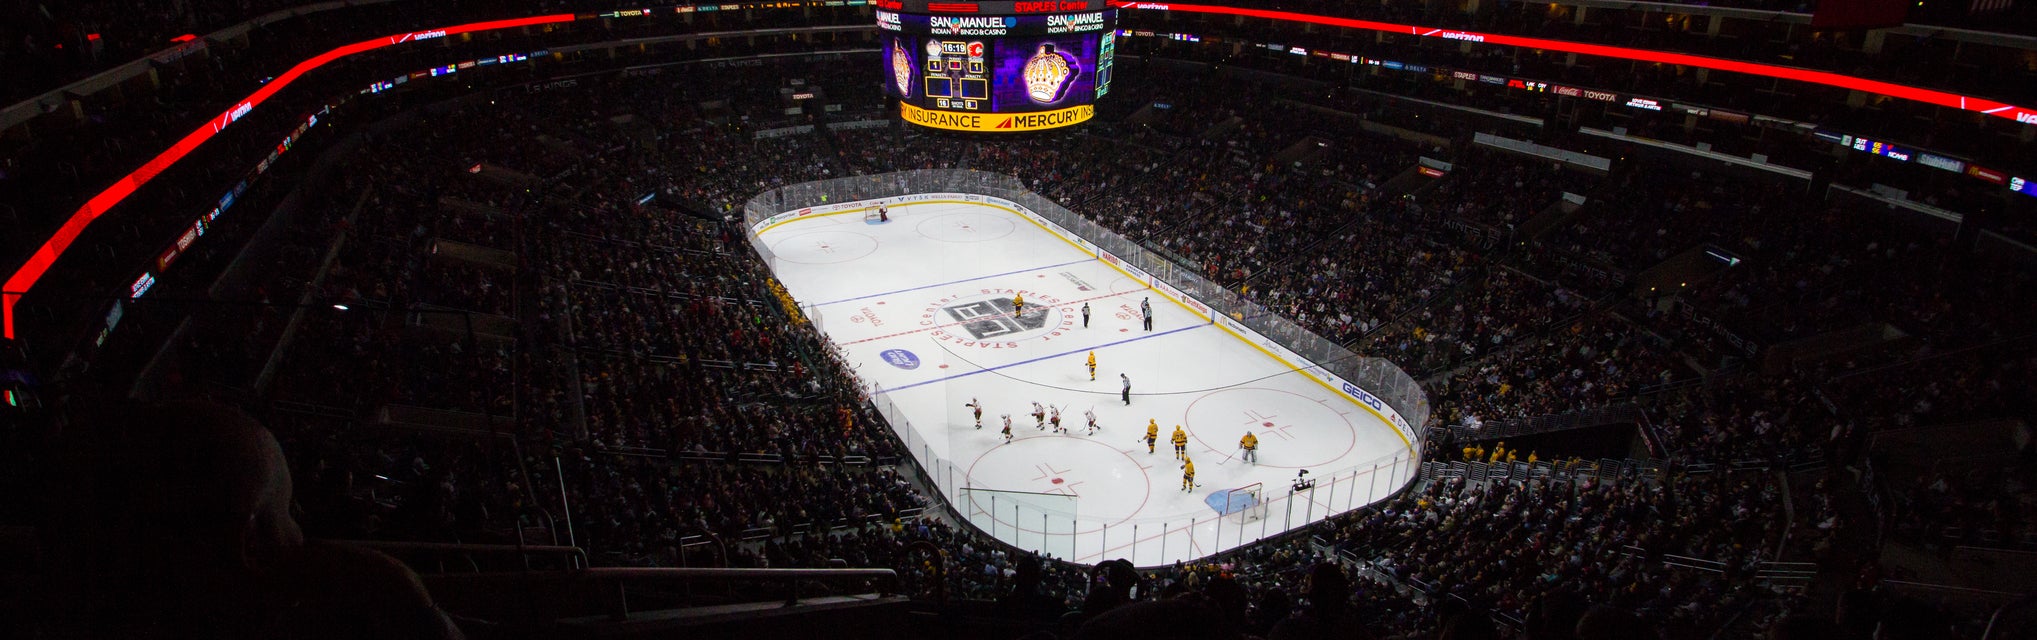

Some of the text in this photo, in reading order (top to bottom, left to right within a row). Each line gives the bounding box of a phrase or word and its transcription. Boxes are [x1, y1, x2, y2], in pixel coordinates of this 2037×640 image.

[1014, 1, 1088, 12] STAPLES Center
[930, 16, 1006, 28] SAN MANUEL
[1047, 12, 1104, 26] SAN MANUEL
[414, 30, 446, 40] verizon
[1442, 32, 1484, 42] verizon
[944, 44, 965, 52] 16:19
[1410, 64, 1427, 72] DELTA
[1454, 72, 1476, 80] STAPLES
[1584, 90, 1616, 102] TOYOTA
[908, 109, 981, 128] INSURANCE
[1015, 109, 1079, 128] MERCURY
[1186, 297, 1208, 314] DraftKings
[980, 288, 1074, 342] STAPLES Center
[920, 294, 1018, 349] STAPLES Center
[1342, 382, 1382, 412] GEICO
